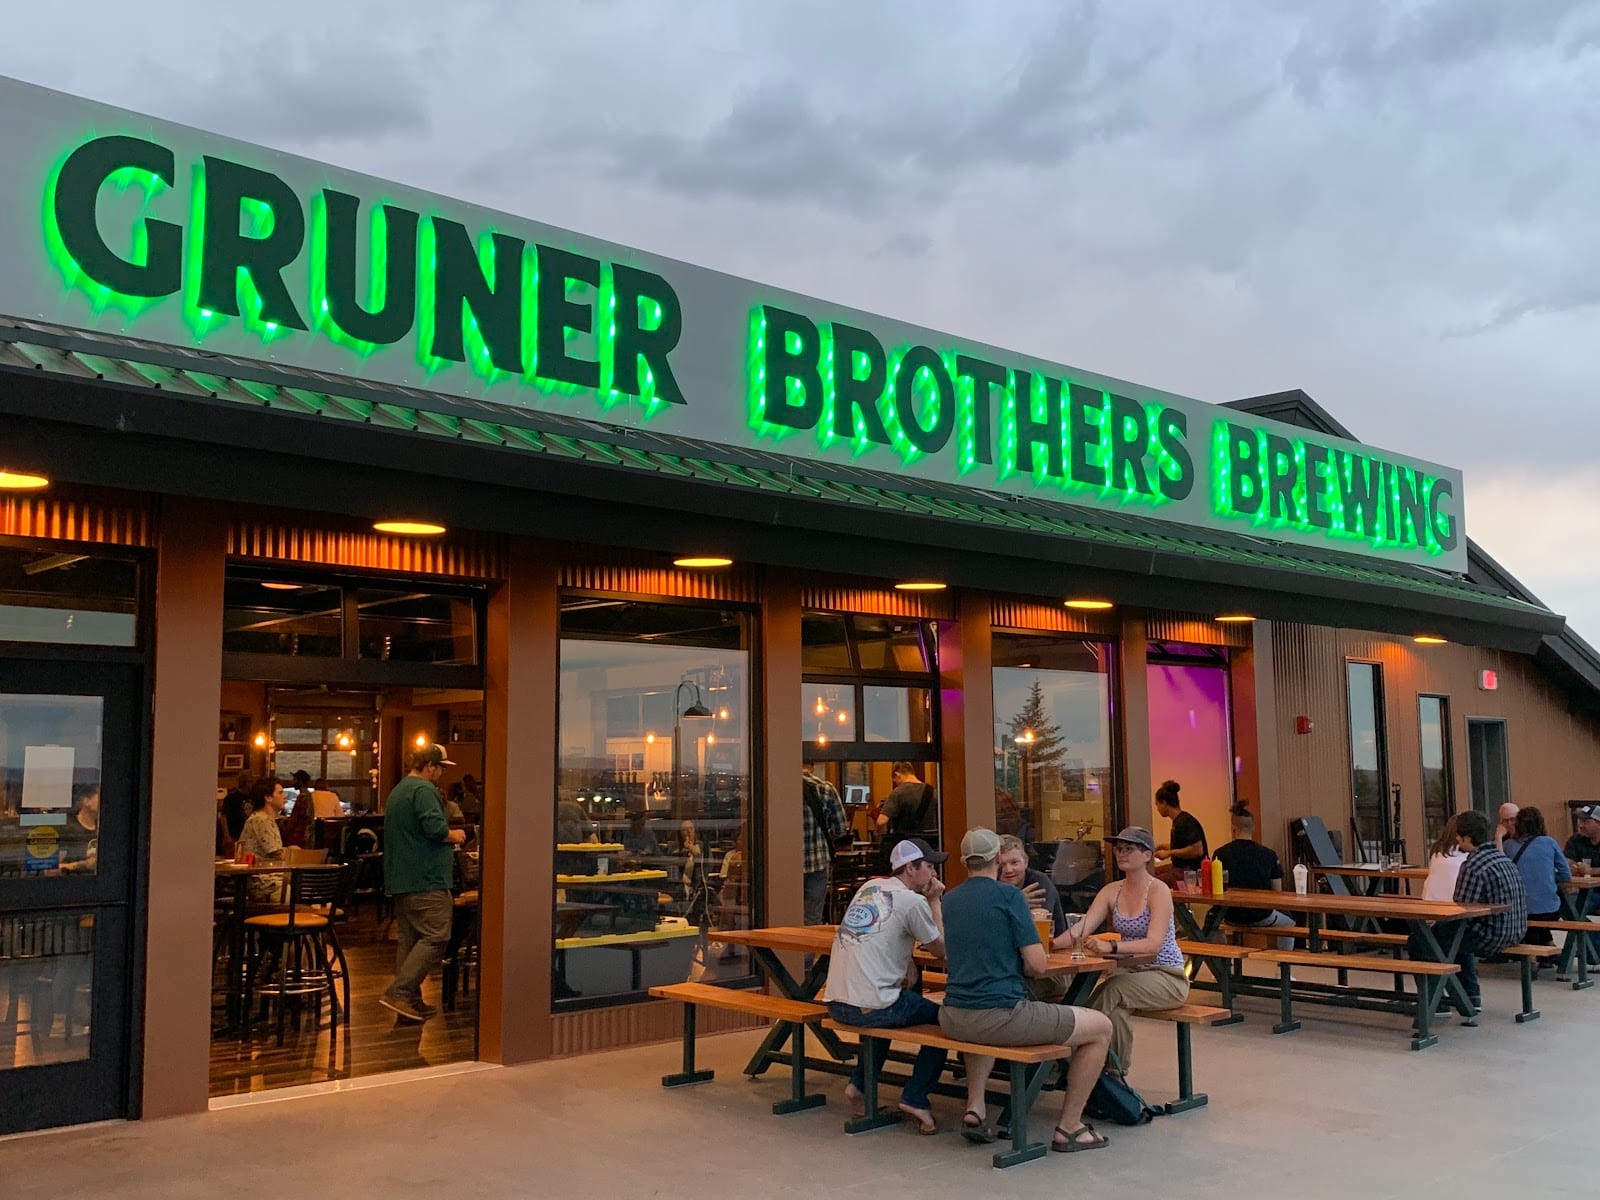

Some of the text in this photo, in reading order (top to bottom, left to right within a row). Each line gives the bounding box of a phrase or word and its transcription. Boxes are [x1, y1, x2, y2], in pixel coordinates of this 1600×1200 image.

[54, 135, 1458, 551] GRUNER BROTHERS BREWING
